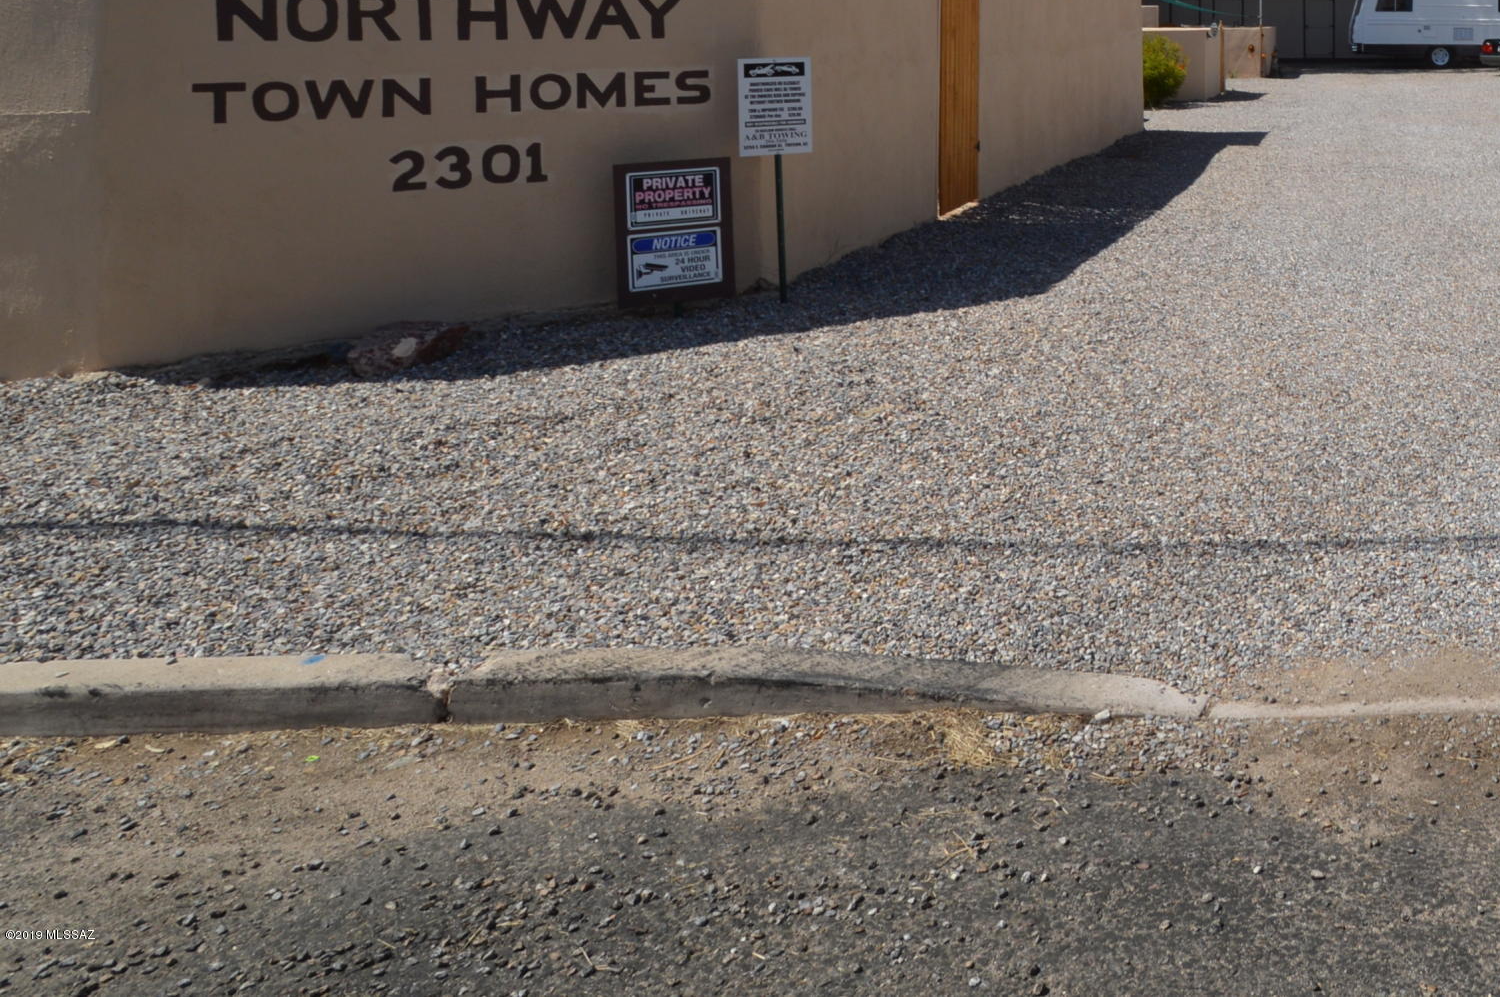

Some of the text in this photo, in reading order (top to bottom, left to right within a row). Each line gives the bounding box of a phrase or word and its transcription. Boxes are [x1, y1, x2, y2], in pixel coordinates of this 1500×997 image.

[192, 69, 712, 124] TOWN HOMES
[768, 131, 808, 140] TOWING
[389, 142, 548, 193] 2301
[643, 175, 704, 190] PRIVATE
[635, 187, 711, 203] PROPERTY
[652, 199, 712, 208] TRESPASSING
[652, 234, 697, 250] NOTICE
[675, 254, 711, 266] 24 HOUR
[681, 264, 706, 272] VIDEO
[660, 271, 711, 282] SURVEILLANCE
